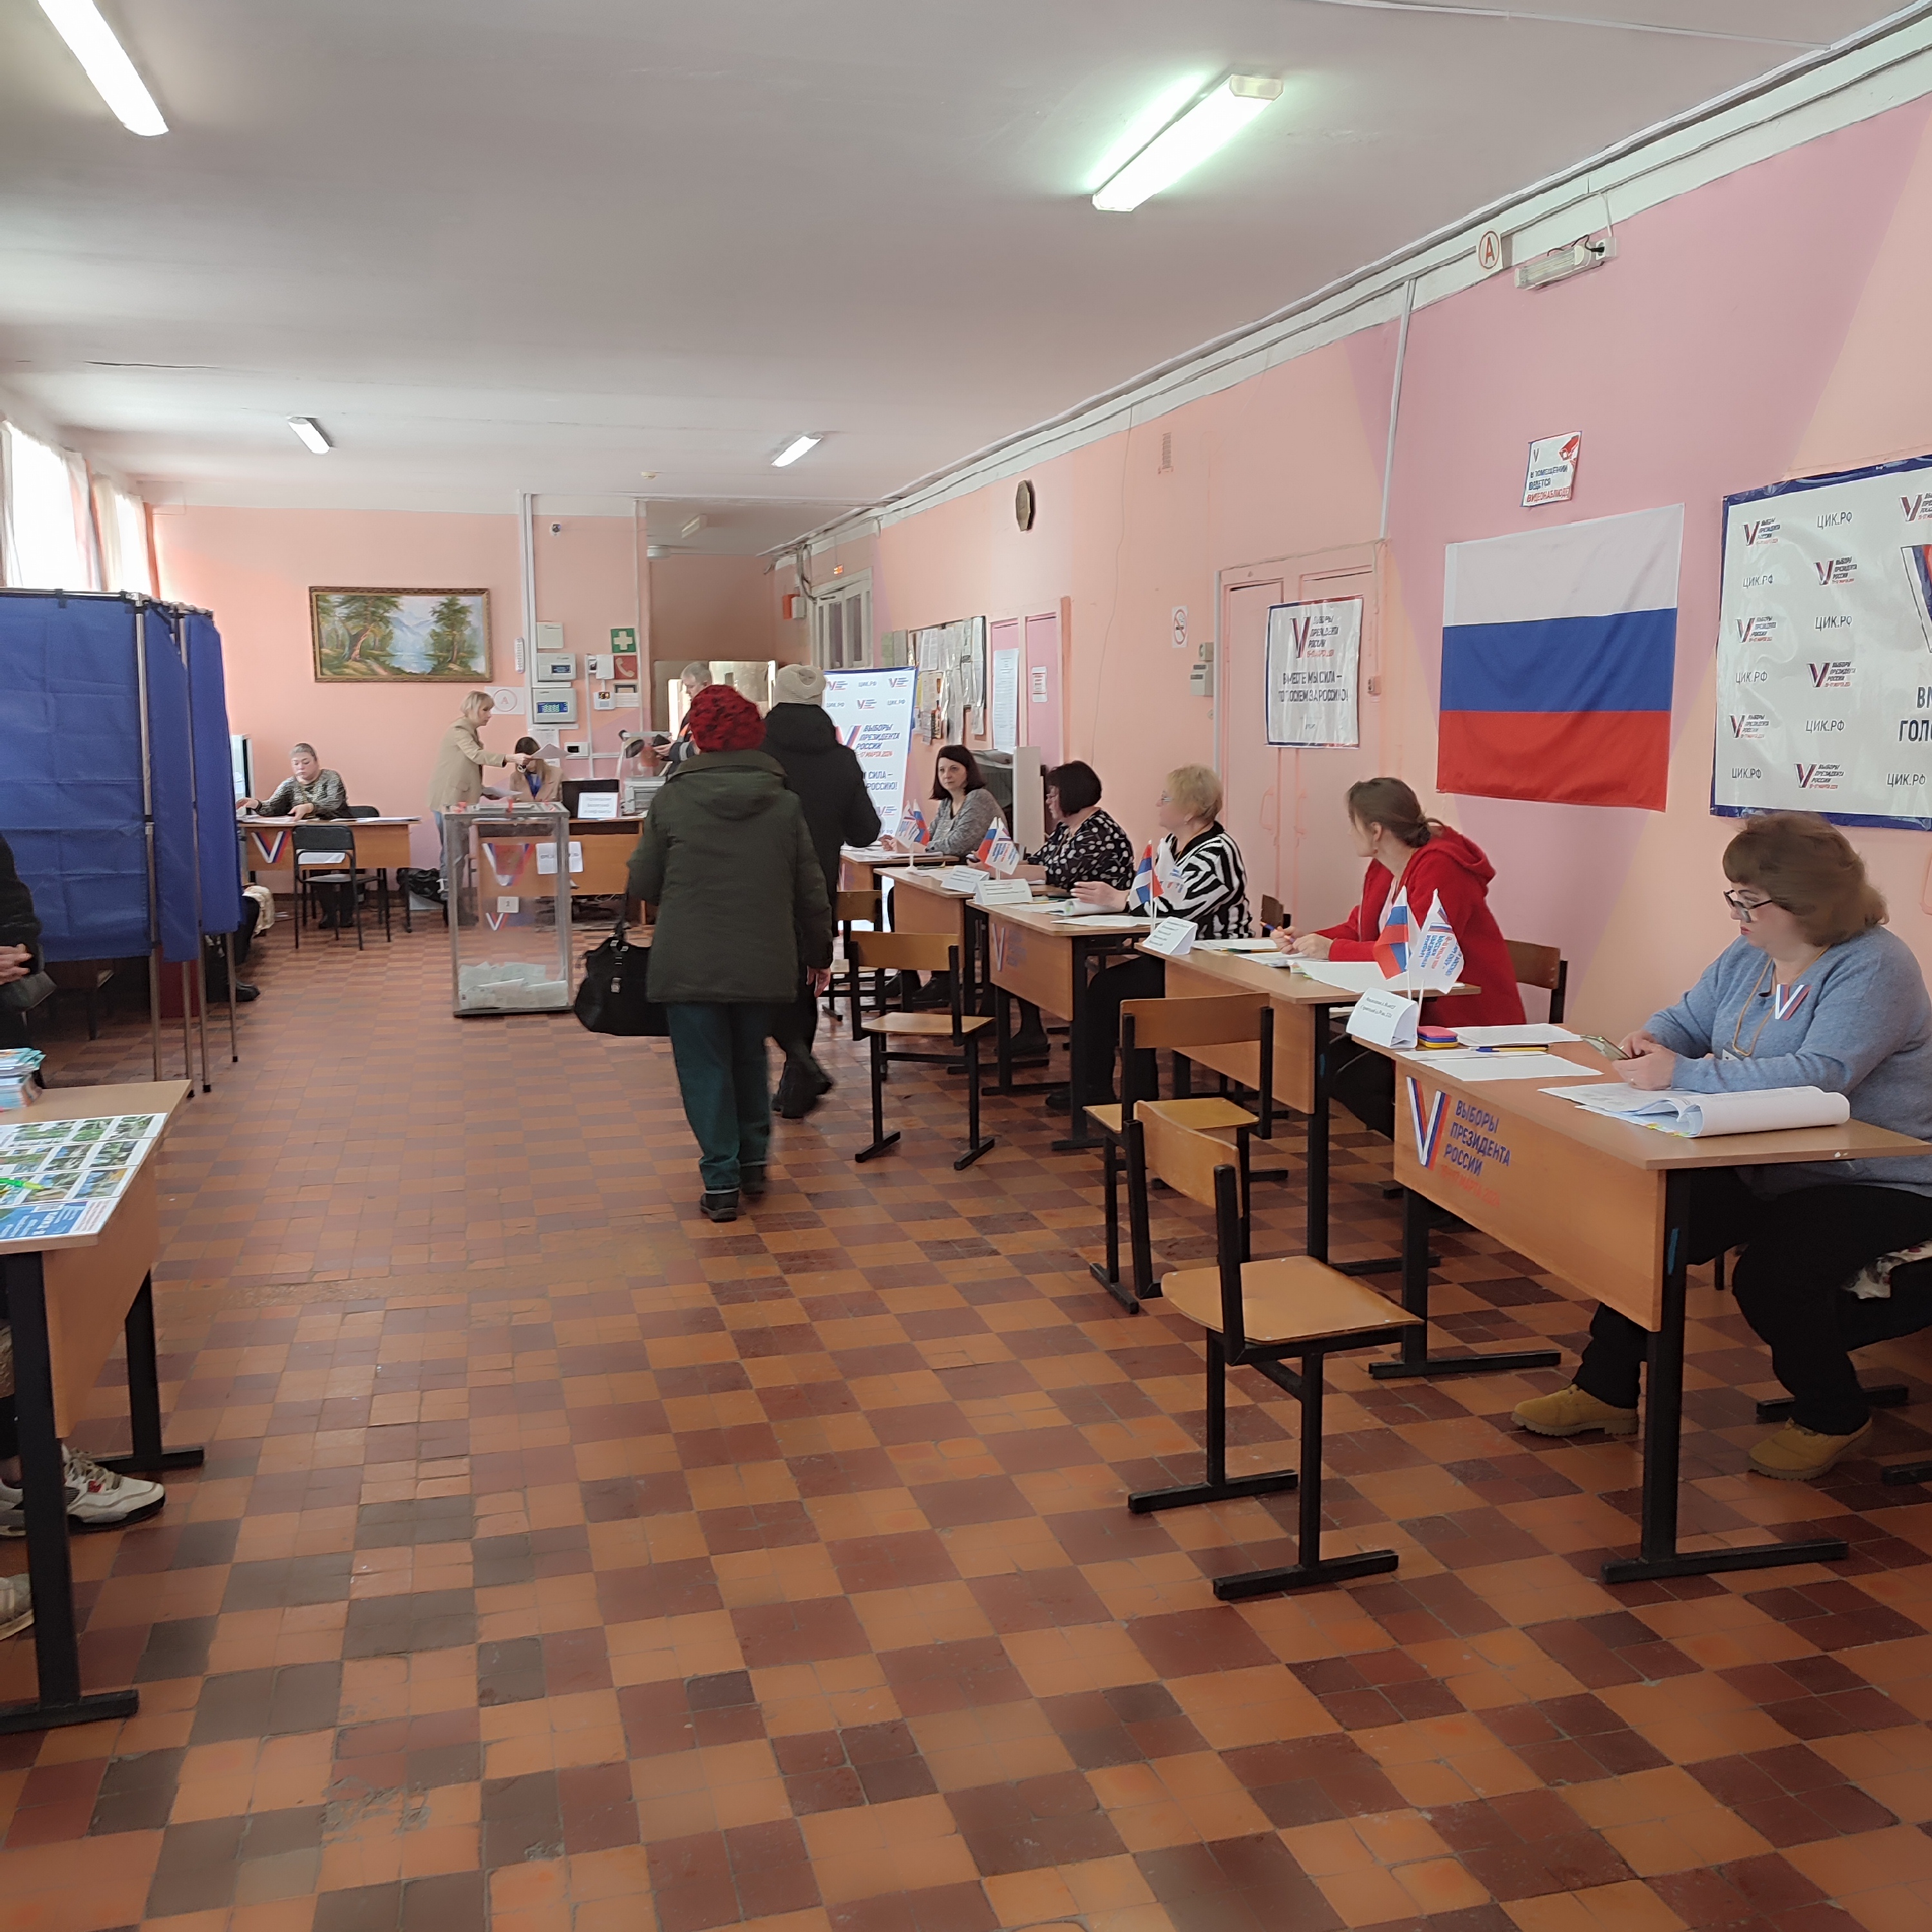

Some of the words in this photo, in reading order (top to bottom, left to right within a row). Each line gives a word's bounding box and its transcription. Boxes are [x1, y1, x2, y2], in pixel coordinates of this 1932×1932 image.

[1817, 512, 1853, 529] ЦИК.РФ
[1743, 574, 1774, 589] ЦИК.РФ
[1815, 616, 1852, 632] ЦИК.РФ
[1736, 671, 1768, 685] ЦИК.РФ
[863, 723, 893, 732] ВЫБОРЫ
[1806, 719, 1845, 734] ЦИК.РФ
[859, 733, 900, 741] ПРЕЗИДЕНТА
[868, 771, 887, 779] СИЛА
[1731, 768, 1763, 779] ЦИК.РФ
[1887, 773, 1926, 788] ЦИК.РФ
[1455, 1100, 1500, 1134] ВЫБОРЫ
[1450, 1121, 1511, 1167] ПРЕЗИДЕНТА
[1444, 1143, 1483, 1177] РОССИИ
